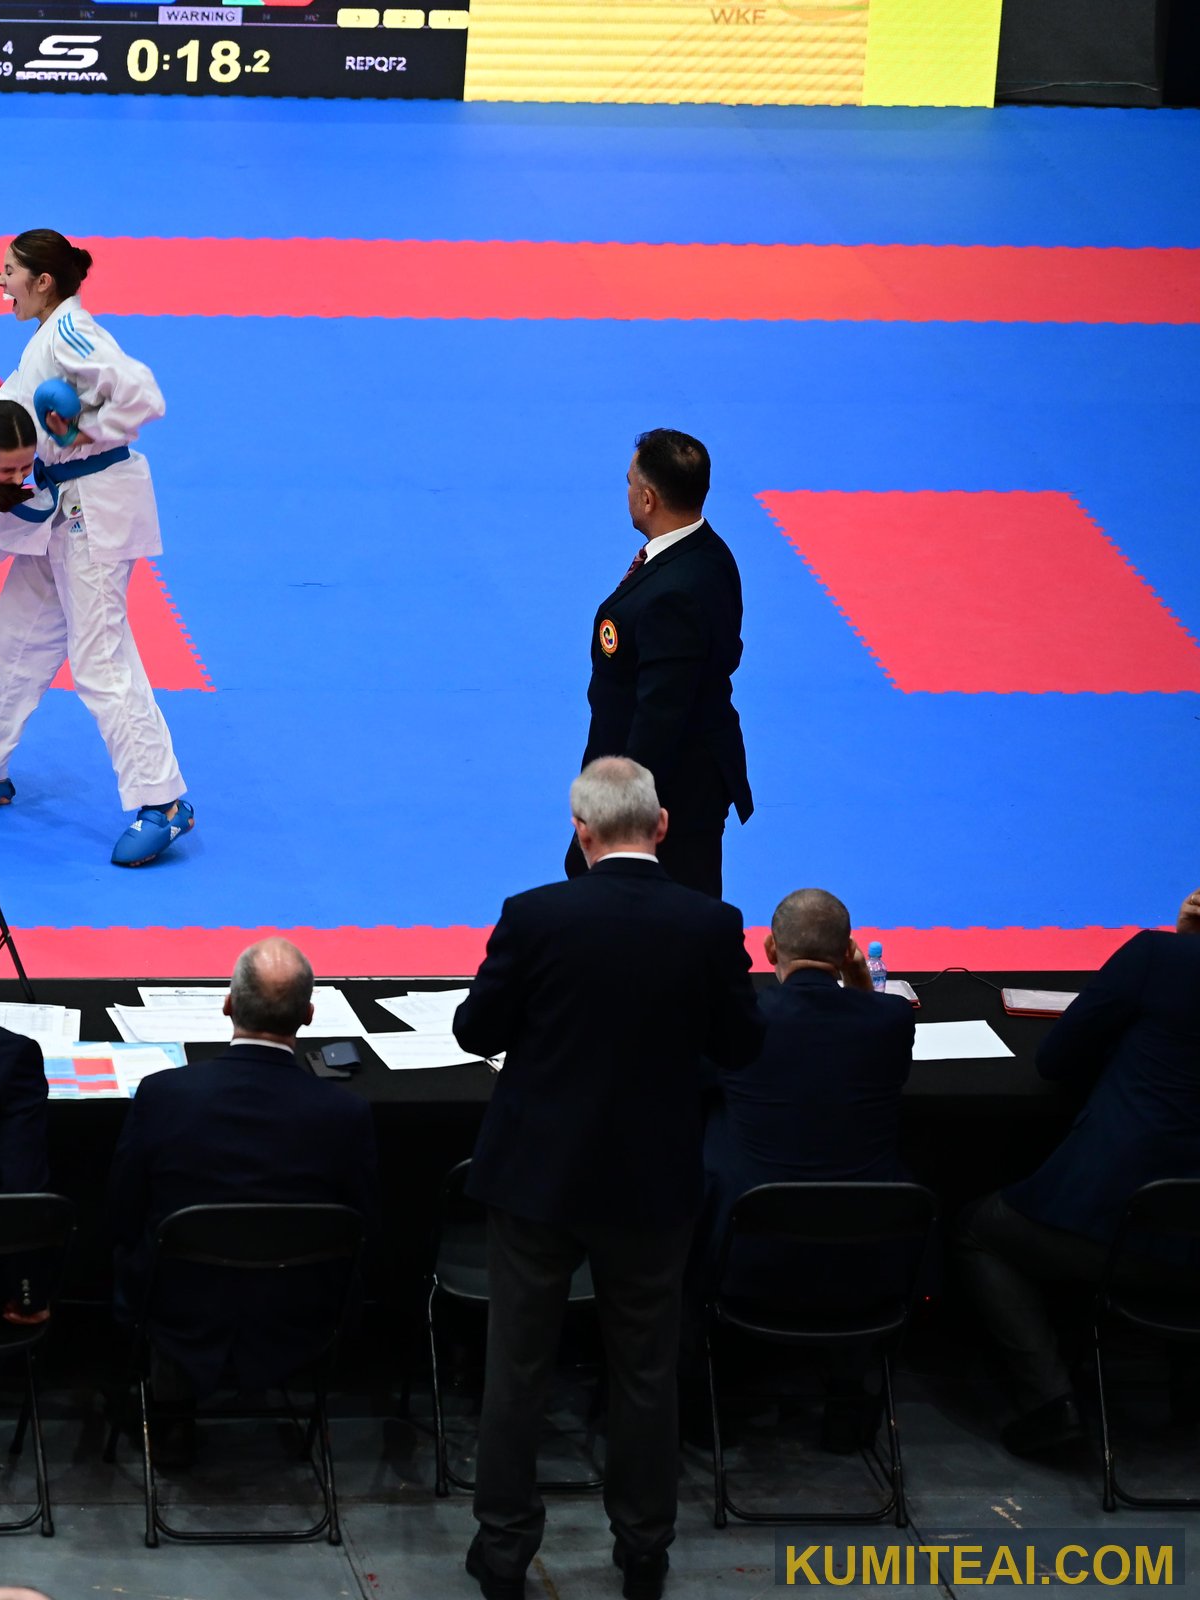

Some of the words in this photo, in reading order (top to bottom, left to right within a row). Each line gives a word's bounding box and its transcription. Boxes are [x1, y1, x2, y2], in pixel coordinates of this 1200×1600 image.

[166, 11, 236, 22] WARNING
[711, 8, 766, 25] WKF
[2, 40, 14, 55] 4
[345, 56, 407, 72] REPQF2
[15, 71, 108, 82] SPORTDATA
